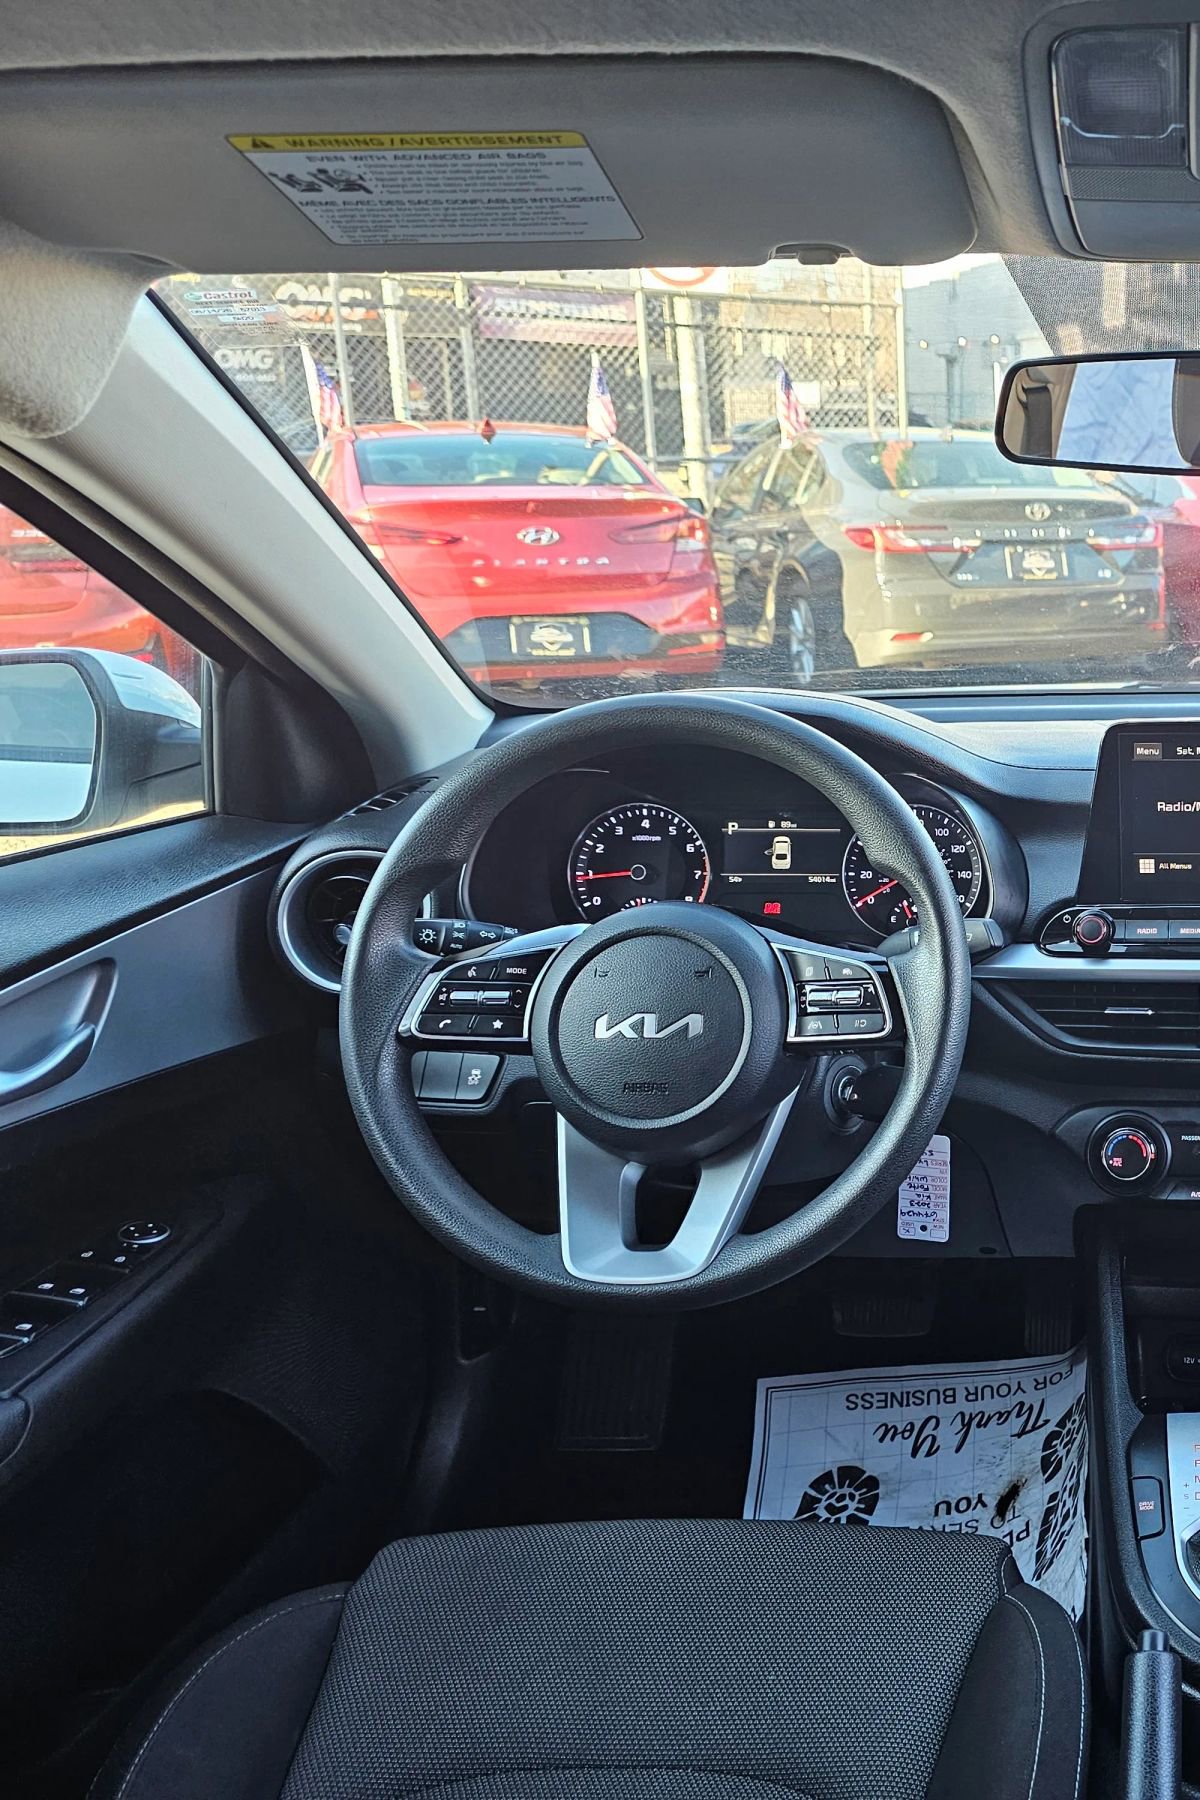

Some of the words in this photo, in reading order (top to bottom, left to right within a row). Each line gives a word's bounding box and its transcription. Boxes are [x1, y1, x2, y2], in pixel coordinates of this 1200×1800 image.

[1136, 747, 1160, 756] Menu
[641, 819, 650, 829] 4
[727, 822, 739, 835] P
[615, 826, 624, 836] 3
[668, 826, 677, 836] 5
[934, 828, 949, 837] 100
[595, 844, 605, 854] 2
[686, 843, 695, 853] 6
[950, 844, 966, 853] 120
[693, 870, 702, 880] 7
[860, 870, 873, 879] 20
[957, 870, 972, 879] 140
[592, 896, 602, 905] 0
[867, 896, 875, 905] 0
[890, 915, 897, 923] E
[506, 967, 528, 975] MODE
[594, 1012, 705, 1039] KIA
[915, 1192, 932, 1201] Kia
[1033, 1363, 1074, 1392] FOR
[964, 1379, 1028, 1402] YOUR
[845, 1387, 957, 1412] BUSINESS
[949, 1397, 1052, 1454] Thank
[872, 1414, 941, 1459] You
[933, 1492, 988, 1518] YOU
